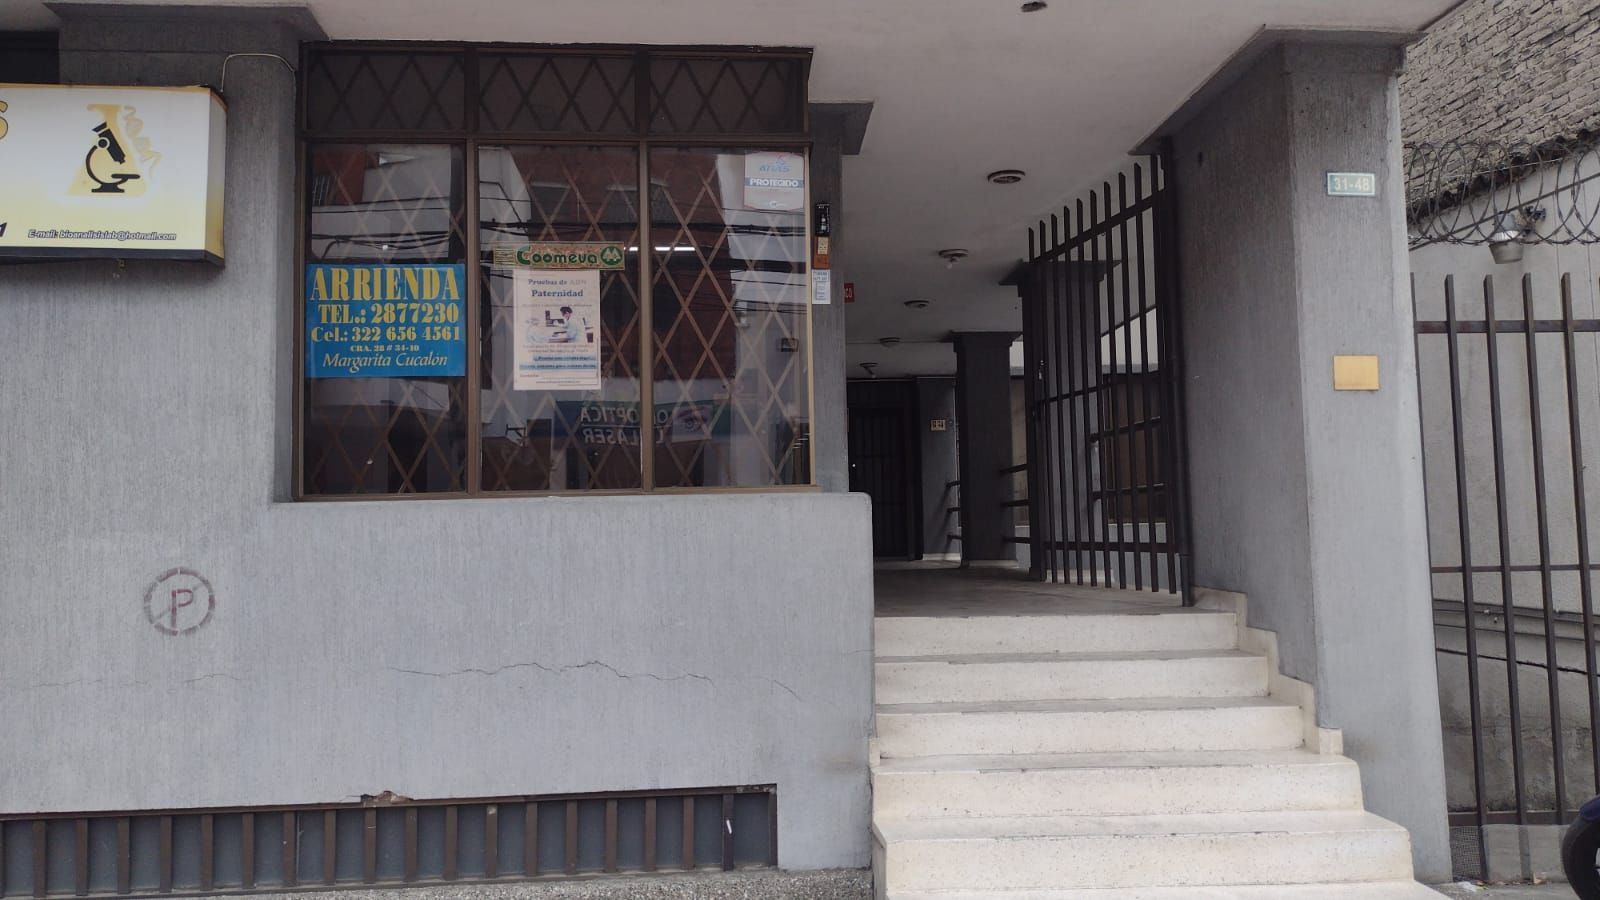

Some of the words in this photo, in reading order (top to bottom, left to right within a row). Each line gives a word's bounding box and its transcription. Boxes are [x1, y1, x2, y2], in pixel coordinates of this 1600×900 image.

[750, 179, 799, 188] PROTEGIDO
[1335, 177, 1371, 192] 31-48
[28, 229, 58, 239] E-mail:
[516, 245, 598, 265] Coomeva
[310, 267, 460, 301] ARRIENDA
[318, 304, 366, 324] TEL.:
[370, 302, 459, 324] 2877230
[311, 326, 348, 342] Cel.:
[352, 326, 382, 342] 322
[385, 326, 417, 342] 656
[422, 326, 460, 342] 4561
[323, 353, 391, 374] Margarita
[396, 351, 448, 368] Cucalón
